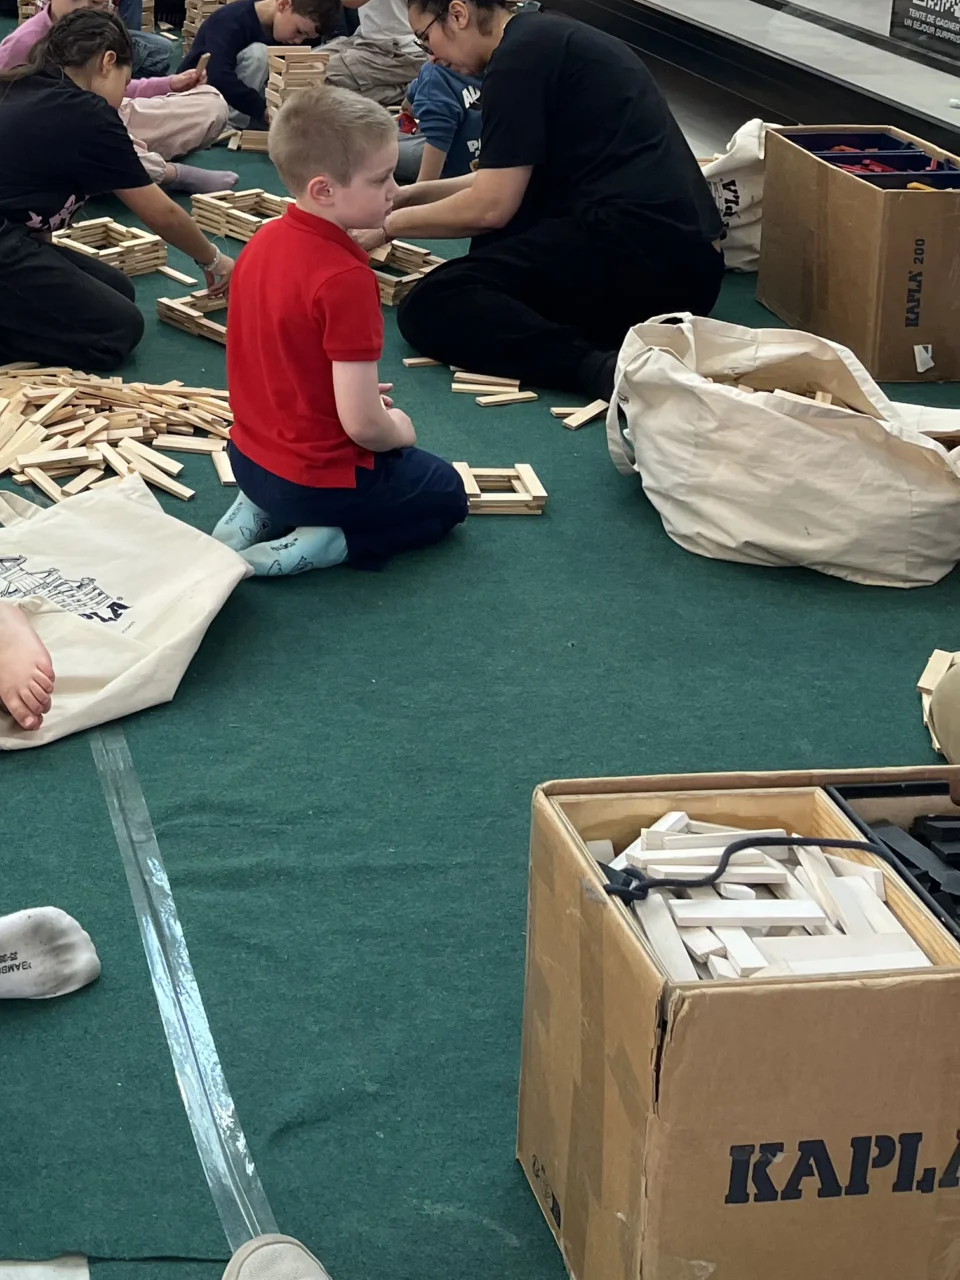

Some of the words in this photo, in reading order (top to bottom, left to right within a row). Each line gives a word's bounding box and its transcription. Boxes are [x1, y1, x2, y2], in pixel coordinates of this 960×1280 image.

[904, 17, 912, 27] UN
[909, 8, 926, 21] TENTE
[927, 14, 936, 23] DE
[936, 17, 960, 32] GAGNER
[905, 270, 923, 328] KAPLA
[914, 238, 925, 265] 200
